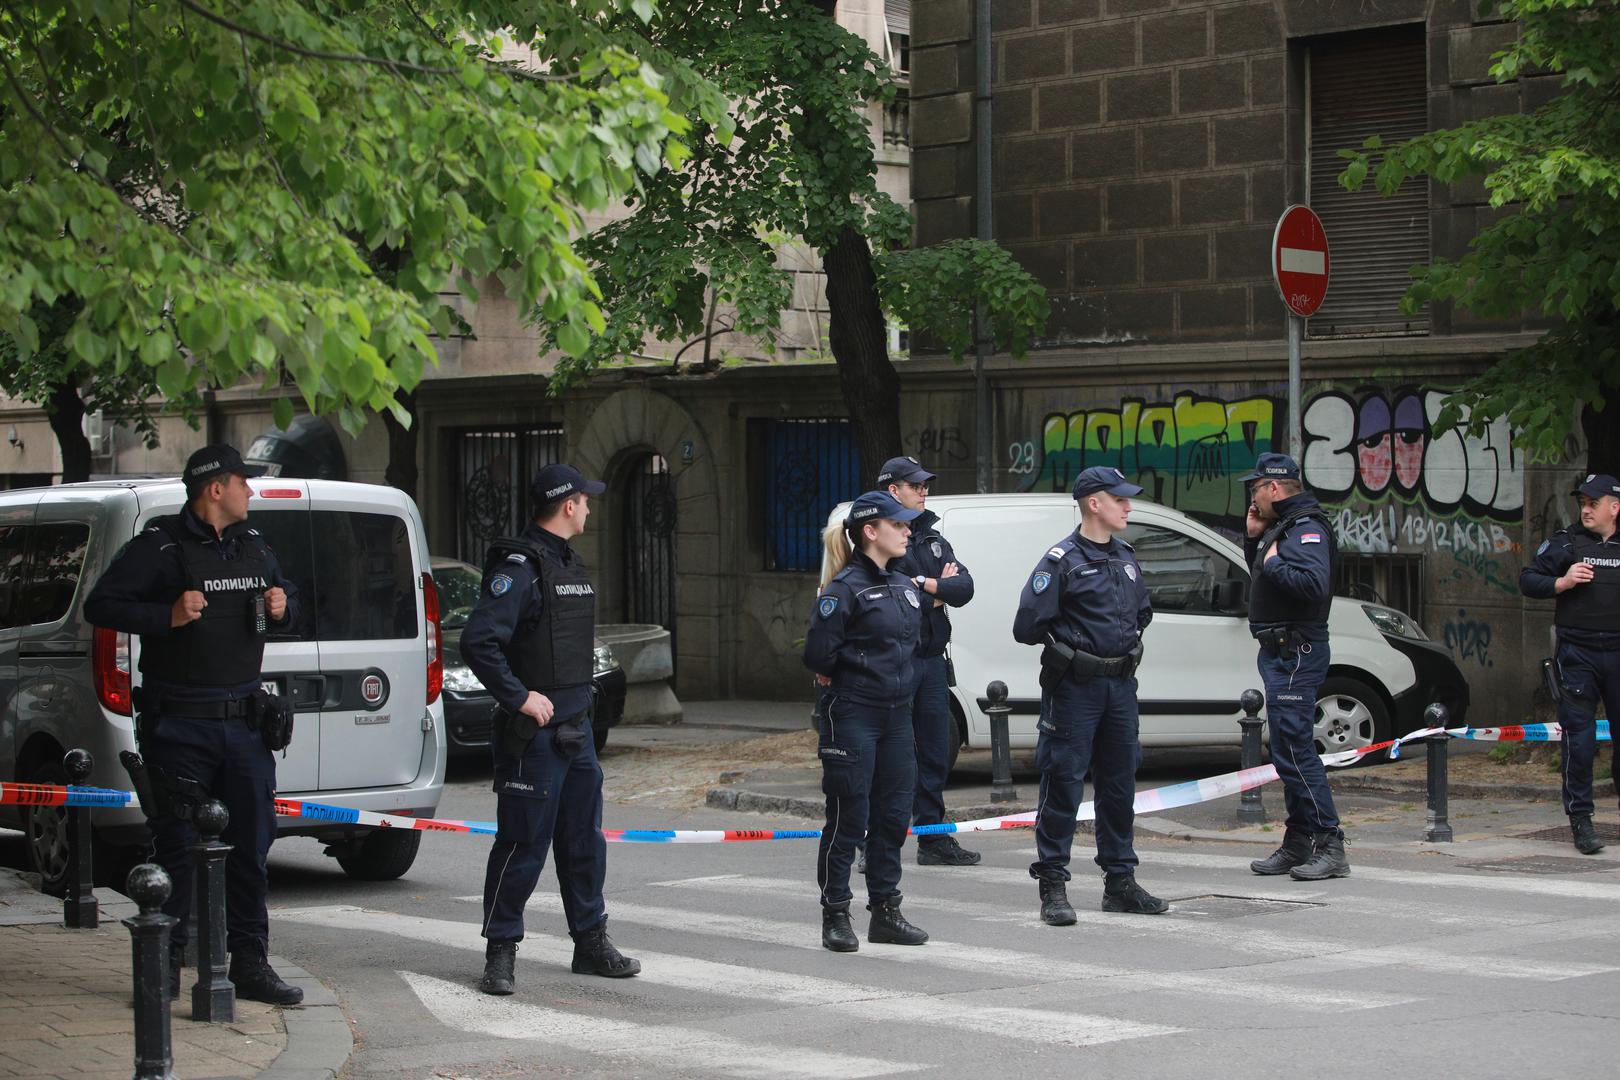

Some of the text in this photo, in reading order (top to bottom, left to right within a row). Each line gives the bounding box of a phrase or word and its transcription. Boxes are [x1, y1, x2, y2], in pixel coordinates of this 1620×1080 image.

[1008, 441, 1035, 473] 23
[1401, 514, 1452, 552] 1312
[1453, 520, 1512, 554] ACAB
[204, 576, 267, 592] ПОЛИЦИЈА
[555, 584, 594, 597] ПОЛИЦИЈА
[366, 683, 380, 696] FIAT
